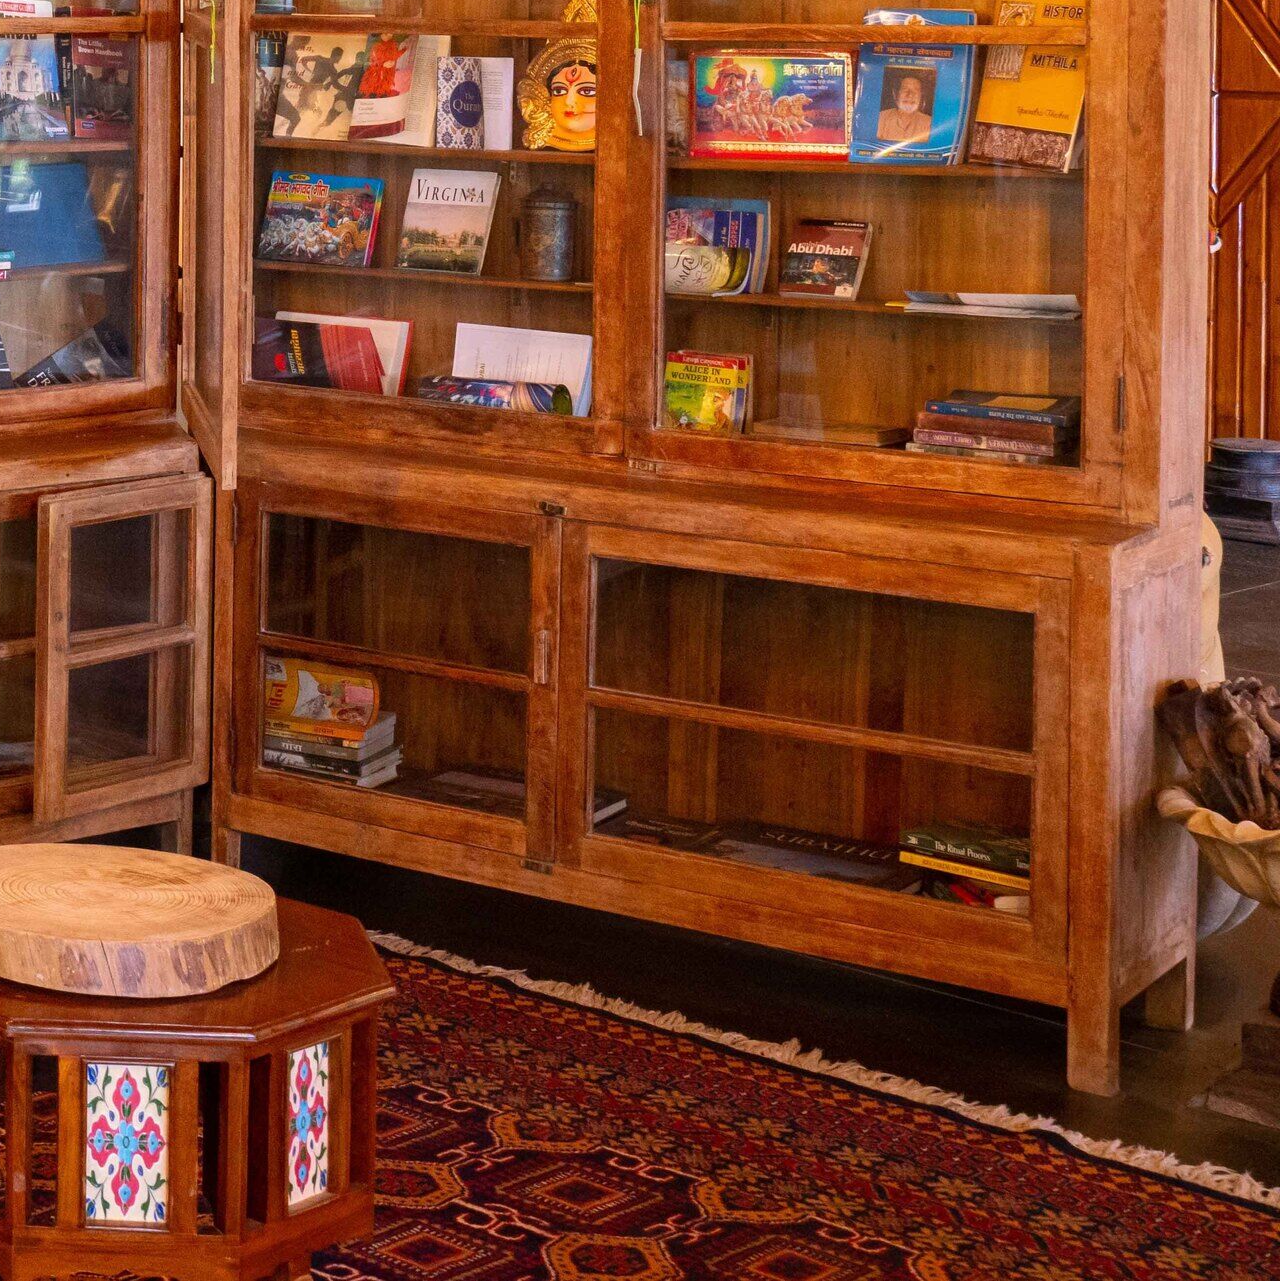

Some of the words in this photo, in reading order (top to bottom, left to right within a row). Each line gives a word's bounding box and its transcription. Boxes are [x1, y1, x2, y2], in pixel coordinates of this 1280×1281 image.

[1043, 5, 1084, 19] HISTOR
[77, 38, 87, 46] The
[78, 47, 95, 55] Brown
[95, 48, 123, 57] Handbook
[1030, 53, 1078, 70] MITHILA
[452, 99, 482, 114] Quran
[416, 178, 485, 204] VIRGINIA
[788, 242, 814, 254] Abu
[815, 243, 854, 256] Dhabi
[683, 364, 709, 376] ALICE
[711, 367, 721, 376] IN
[671, 371, 732, 386] WONDERLAND
[934, 840, 946, 851] The
[946, 842, 966, 855] Ritual
[966, 846, 991, 862] Process
